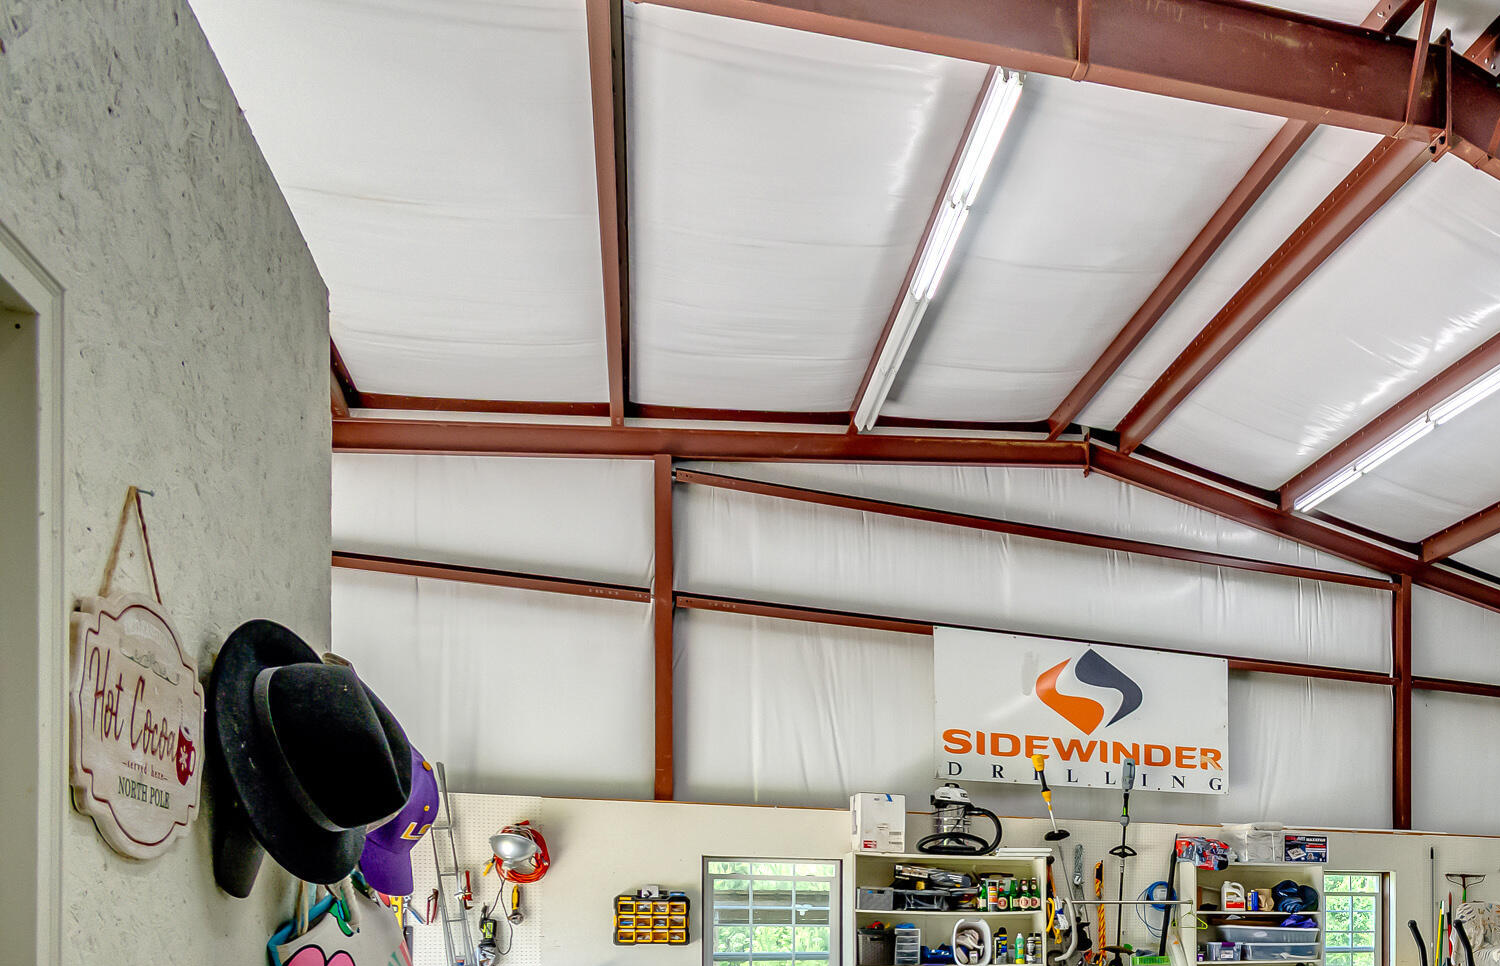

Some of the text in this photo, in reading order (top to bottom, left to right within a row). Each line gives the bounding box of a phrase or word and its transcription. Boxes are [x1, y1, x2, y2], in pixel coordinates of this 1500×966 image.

[88, 646, 124, 742] Hot
[130, 675, 177, 762] Cocoa
[941, 728, 1224, 772] SIDEWINDER
[118, 775, 170, 810] NORTH POLE
[948, 761, 1223, 791] DRILLING
